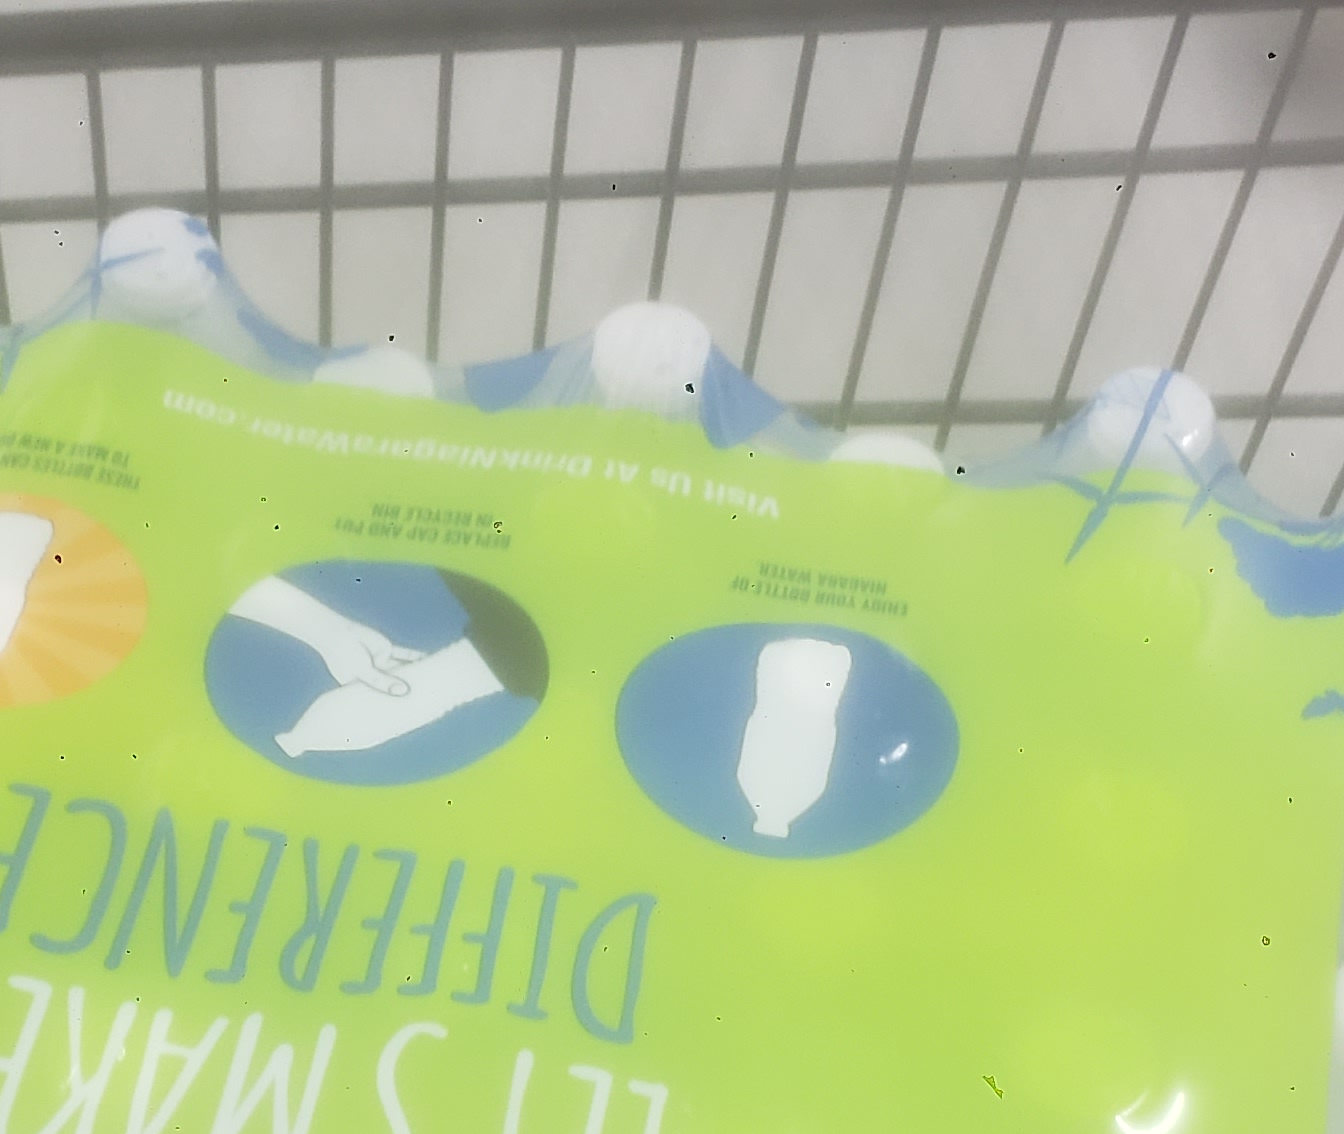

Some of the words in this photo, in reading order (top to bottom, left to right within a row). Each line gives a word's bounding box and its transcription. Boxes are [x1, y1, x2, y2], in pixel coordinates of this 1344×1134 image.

[163, 388, 594, 478] DrinkNiagaraWater.com
[603, 458, 640, 483] At
[650, 466, 693, 497] Us
[702, 478, 780, 519] Visit
[369, 522, 404, 541] AND
[406, 525, 440, 544] CAP
[815, 591, 856, 609] YOUR
[863, 598, 909, 617] ENJOY
